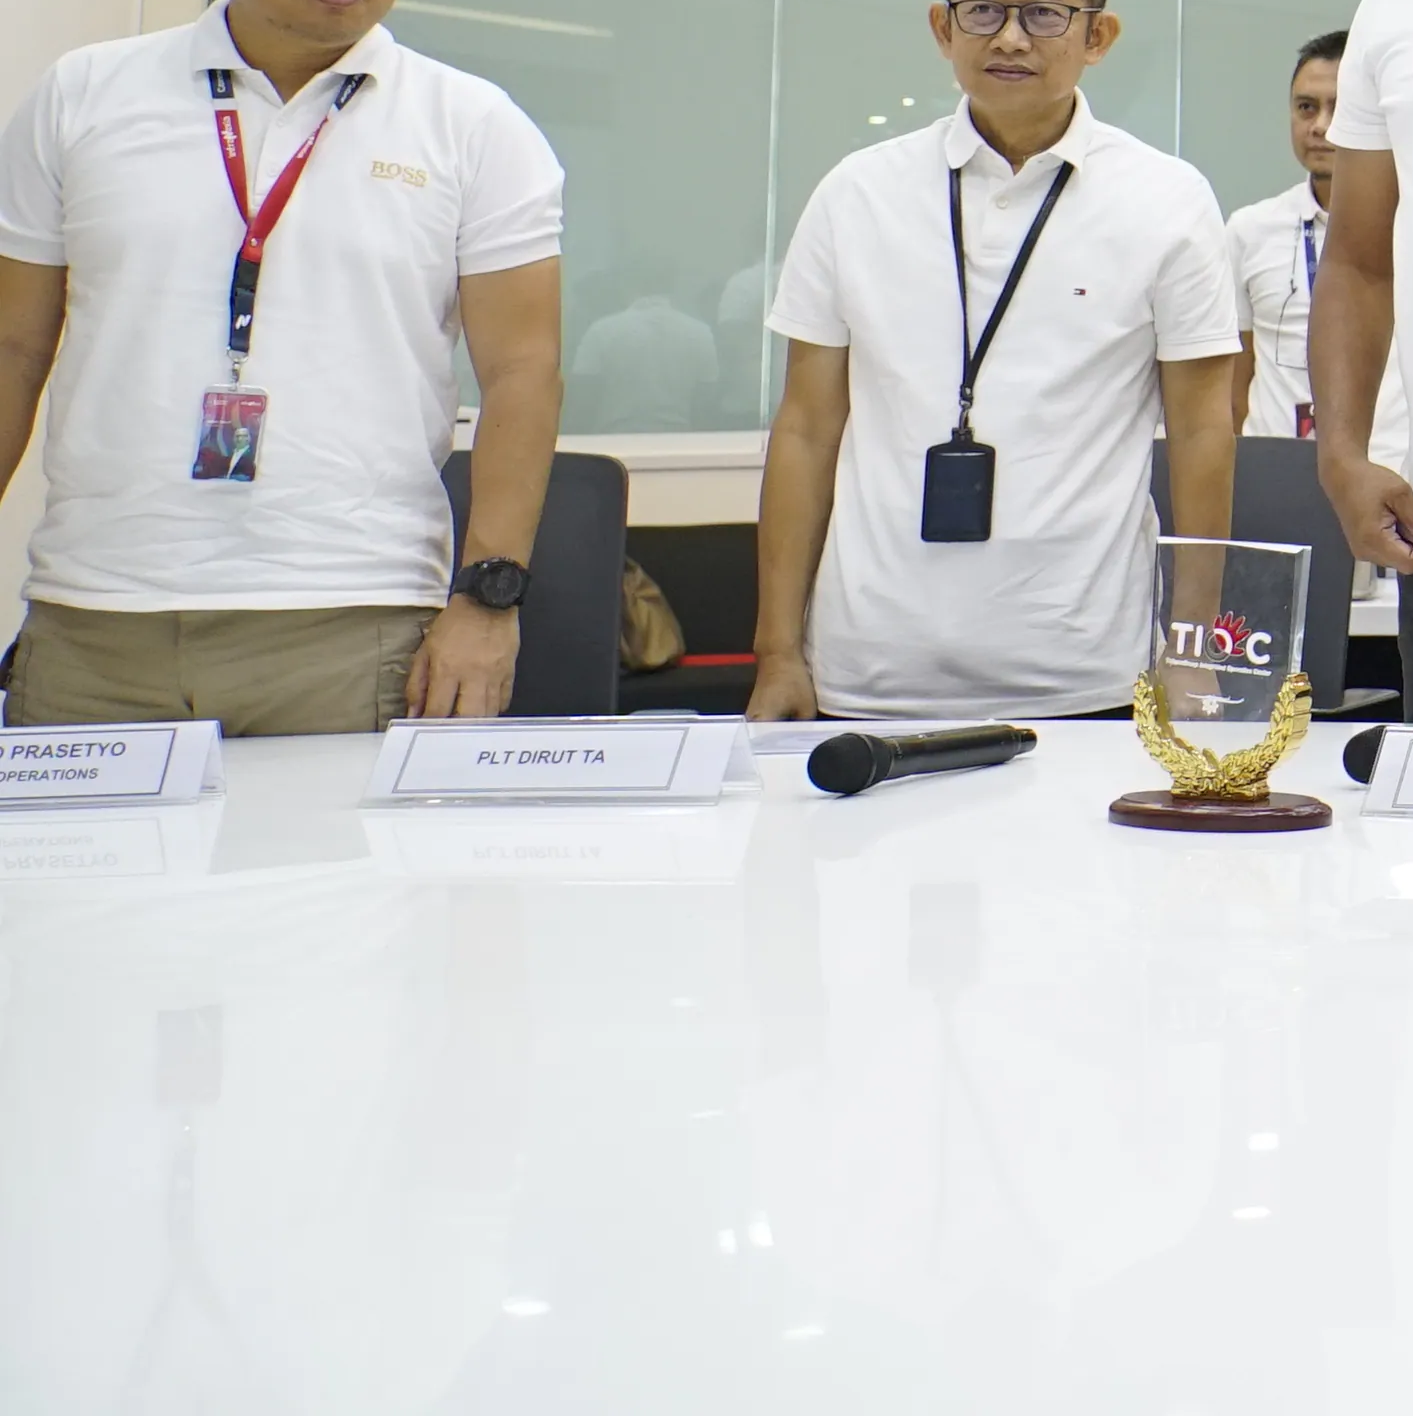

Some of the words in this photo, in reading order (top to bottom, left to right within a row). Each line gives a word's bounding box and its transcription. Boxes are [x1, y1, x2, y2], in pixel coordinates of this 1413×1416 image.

[371, 161, 427, 186] BOSS
[10, 741, 126, 760] PRASETYO
[476, 750, 515, 765] PLT
[517, 749, 579, 765] DIRUT
[582, 749, 606, 764] TA
